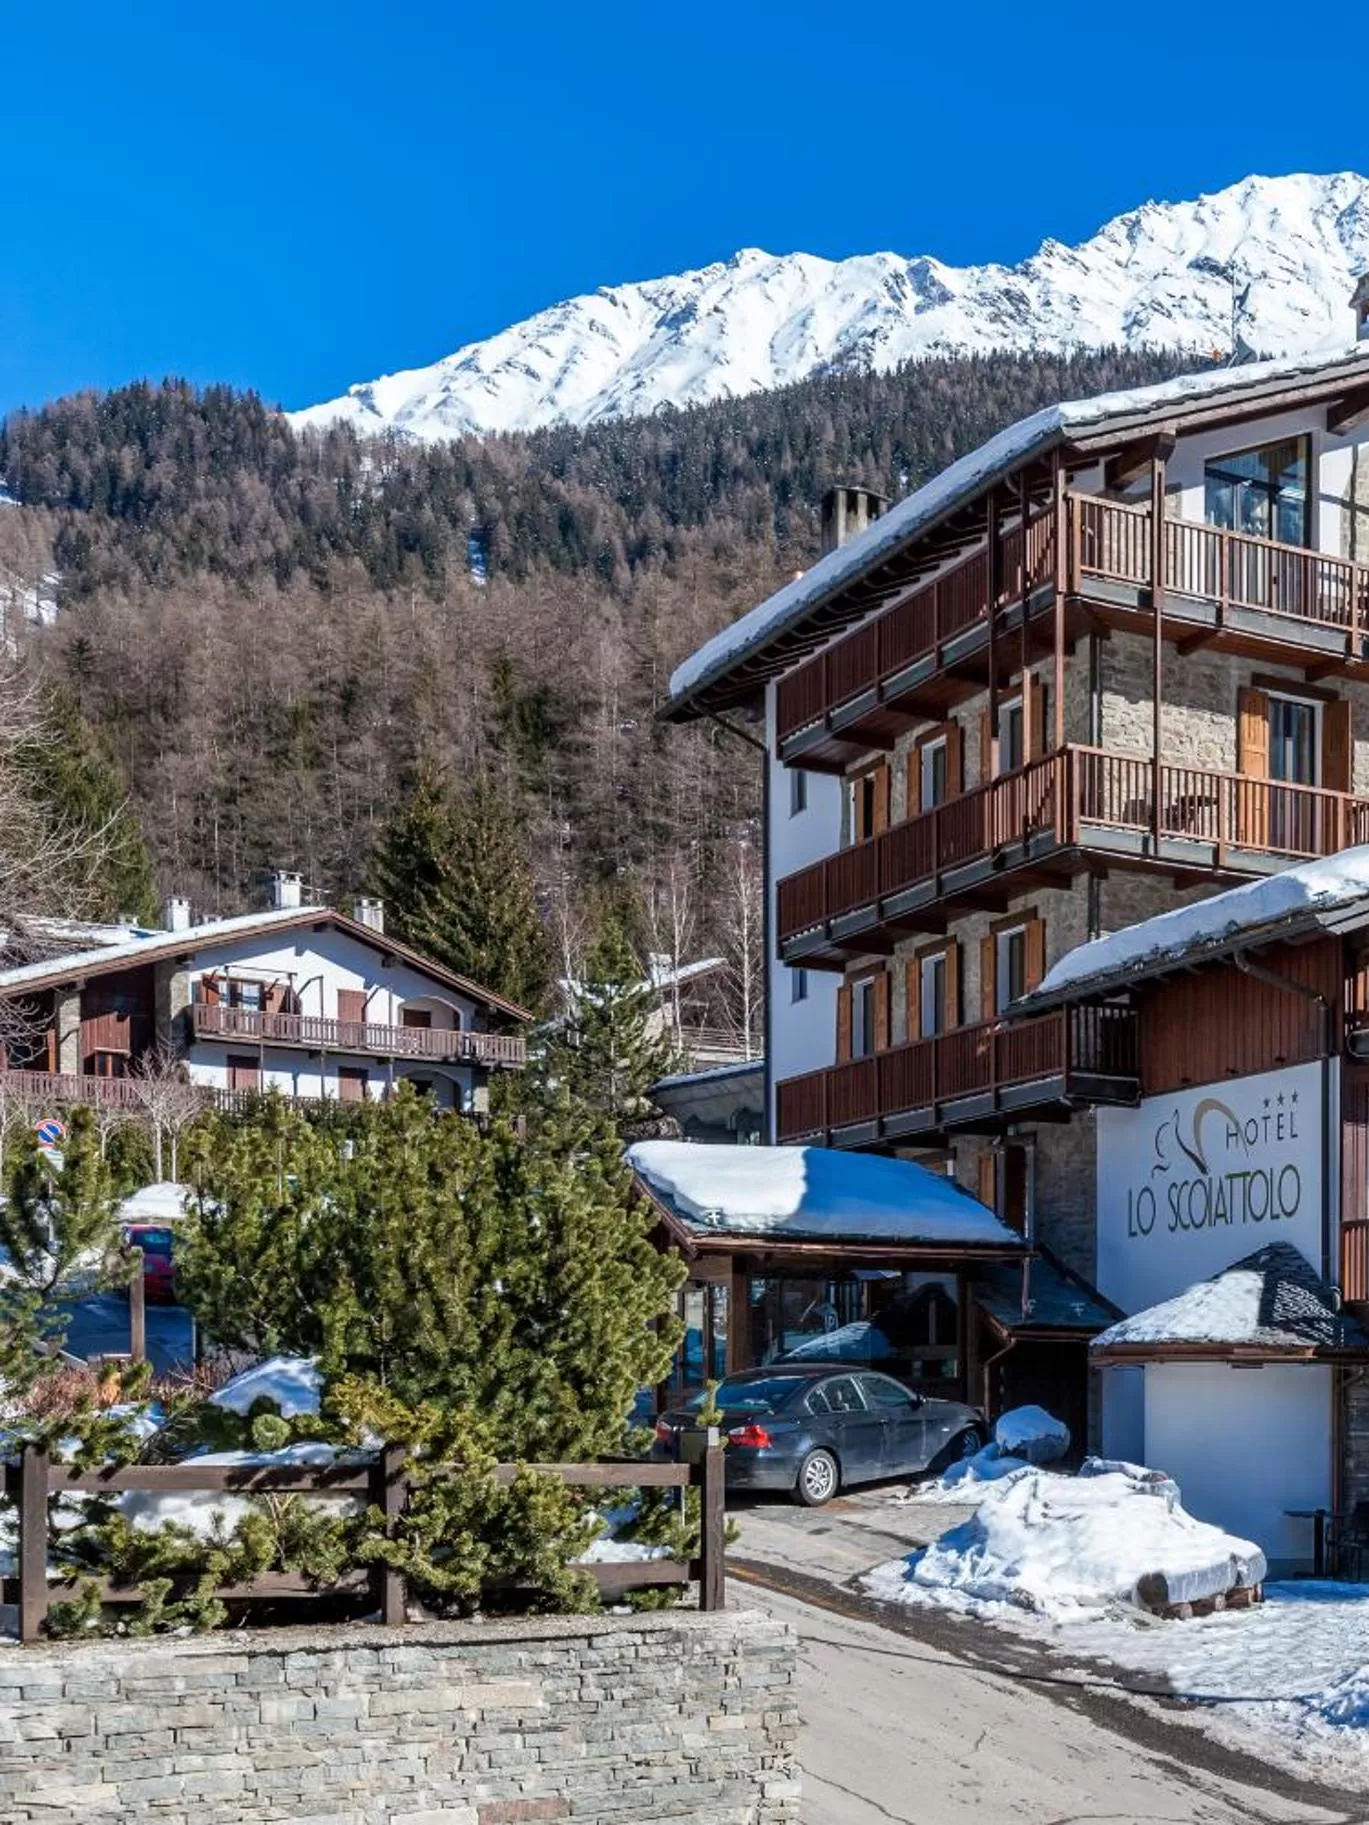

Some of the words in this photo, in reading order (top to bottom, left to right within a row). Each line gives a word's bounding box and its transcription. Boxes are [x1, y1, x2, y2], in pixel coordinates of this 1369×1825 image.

[1226, 1110, 1299, 1149] HOTEL
[1128, 1186, 1157, 1238] LO
[1167, 1163, 1301, 1233] SCOIATTOLO
